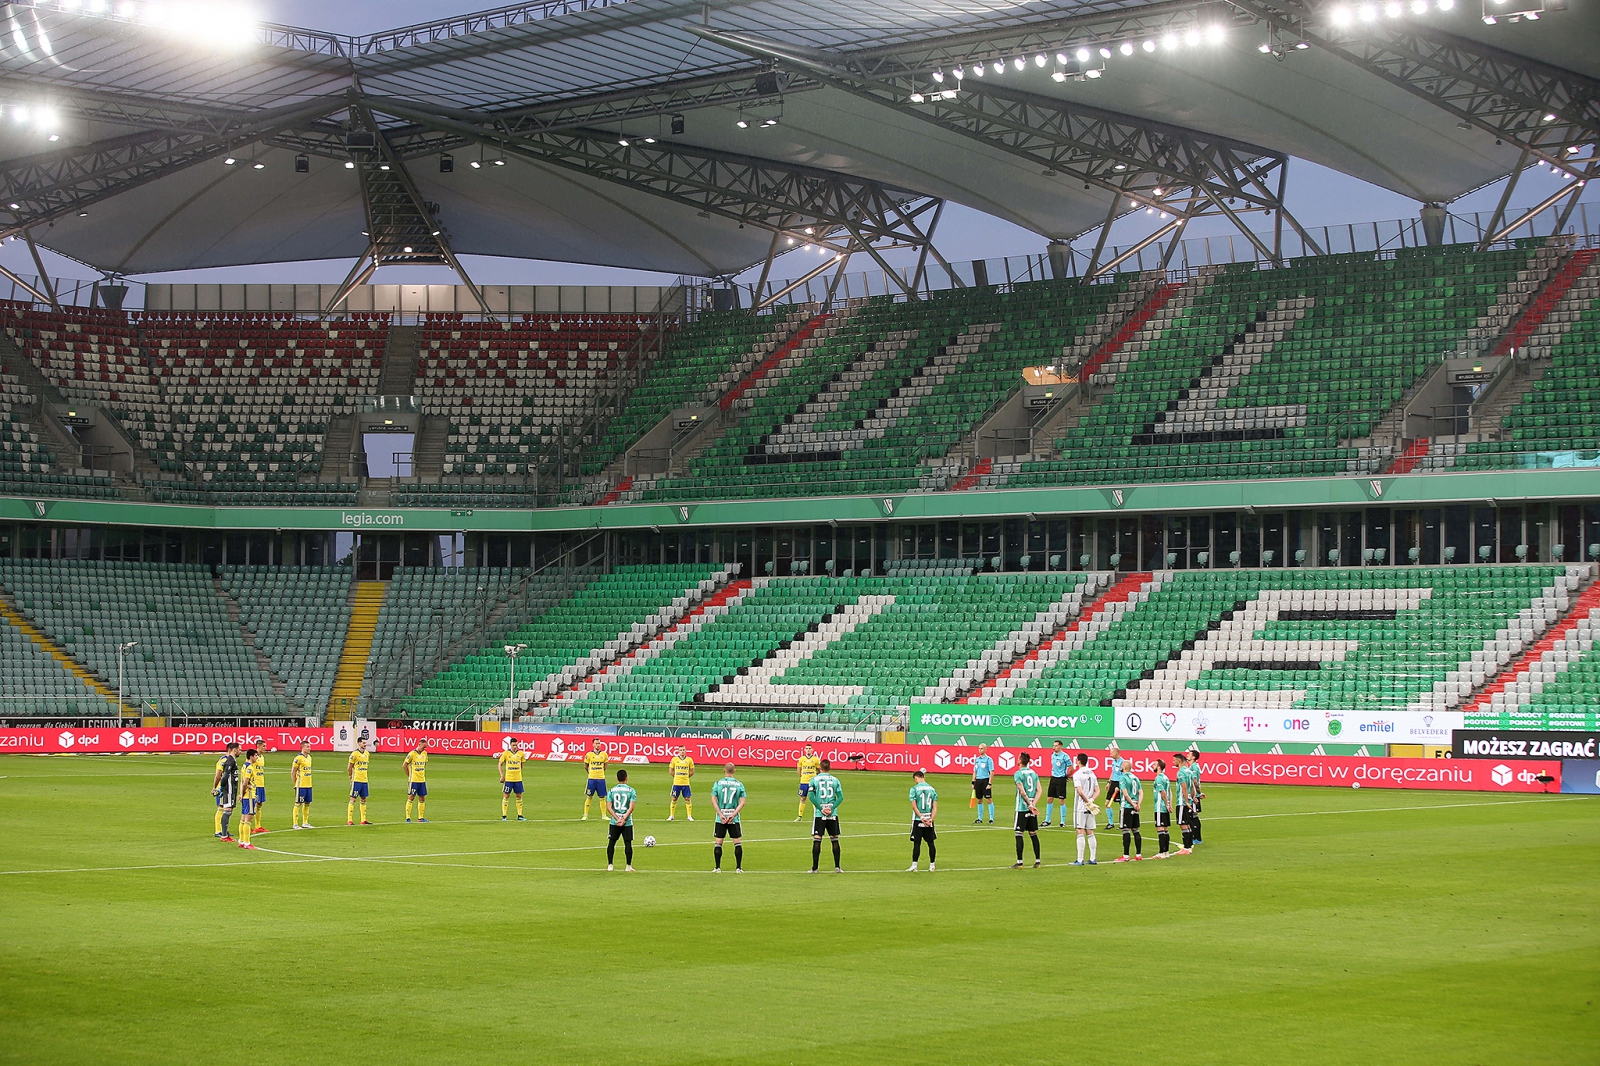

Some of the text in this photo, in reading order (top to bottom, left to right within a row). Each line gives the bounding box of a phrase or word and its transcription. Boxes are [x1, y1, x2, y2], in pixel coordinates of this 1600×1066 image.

[342, 512, 404, 526] legia.com
[1283, 718, 1310, 730] one
[78, 735, 99, 746] dpd
[138, 734, 159, 746] dpd
[172, 733, 208, 745] DPD
[212, 732, 262, 745] Polska
[277, 733, 324, 745] Twoi
[404, 738, 417, 746] w
[567, 741, 585, 753] dpd
[1463, 736, 1595, 756] MOŻESZ ZAGRAĆ
[633, 743, 681, 757] Polska
[696, 744, 734, 758] Twoi
[738, 745, 804, 762] eksperci
[1238, 761, 1323, 780] eksperci
[1328, 766, 1349, 779] w
[1353, 763, 1472, 783] doręczaniu
[819, 781, 834, 799] 55
[1026, 775, 1034, 792] 9
[1131, 779, 1138, 796] 8
[613, 793, 628, 810] 82
[722, 787, 737, 804] 17
[919, 792, 932, 810] 14
